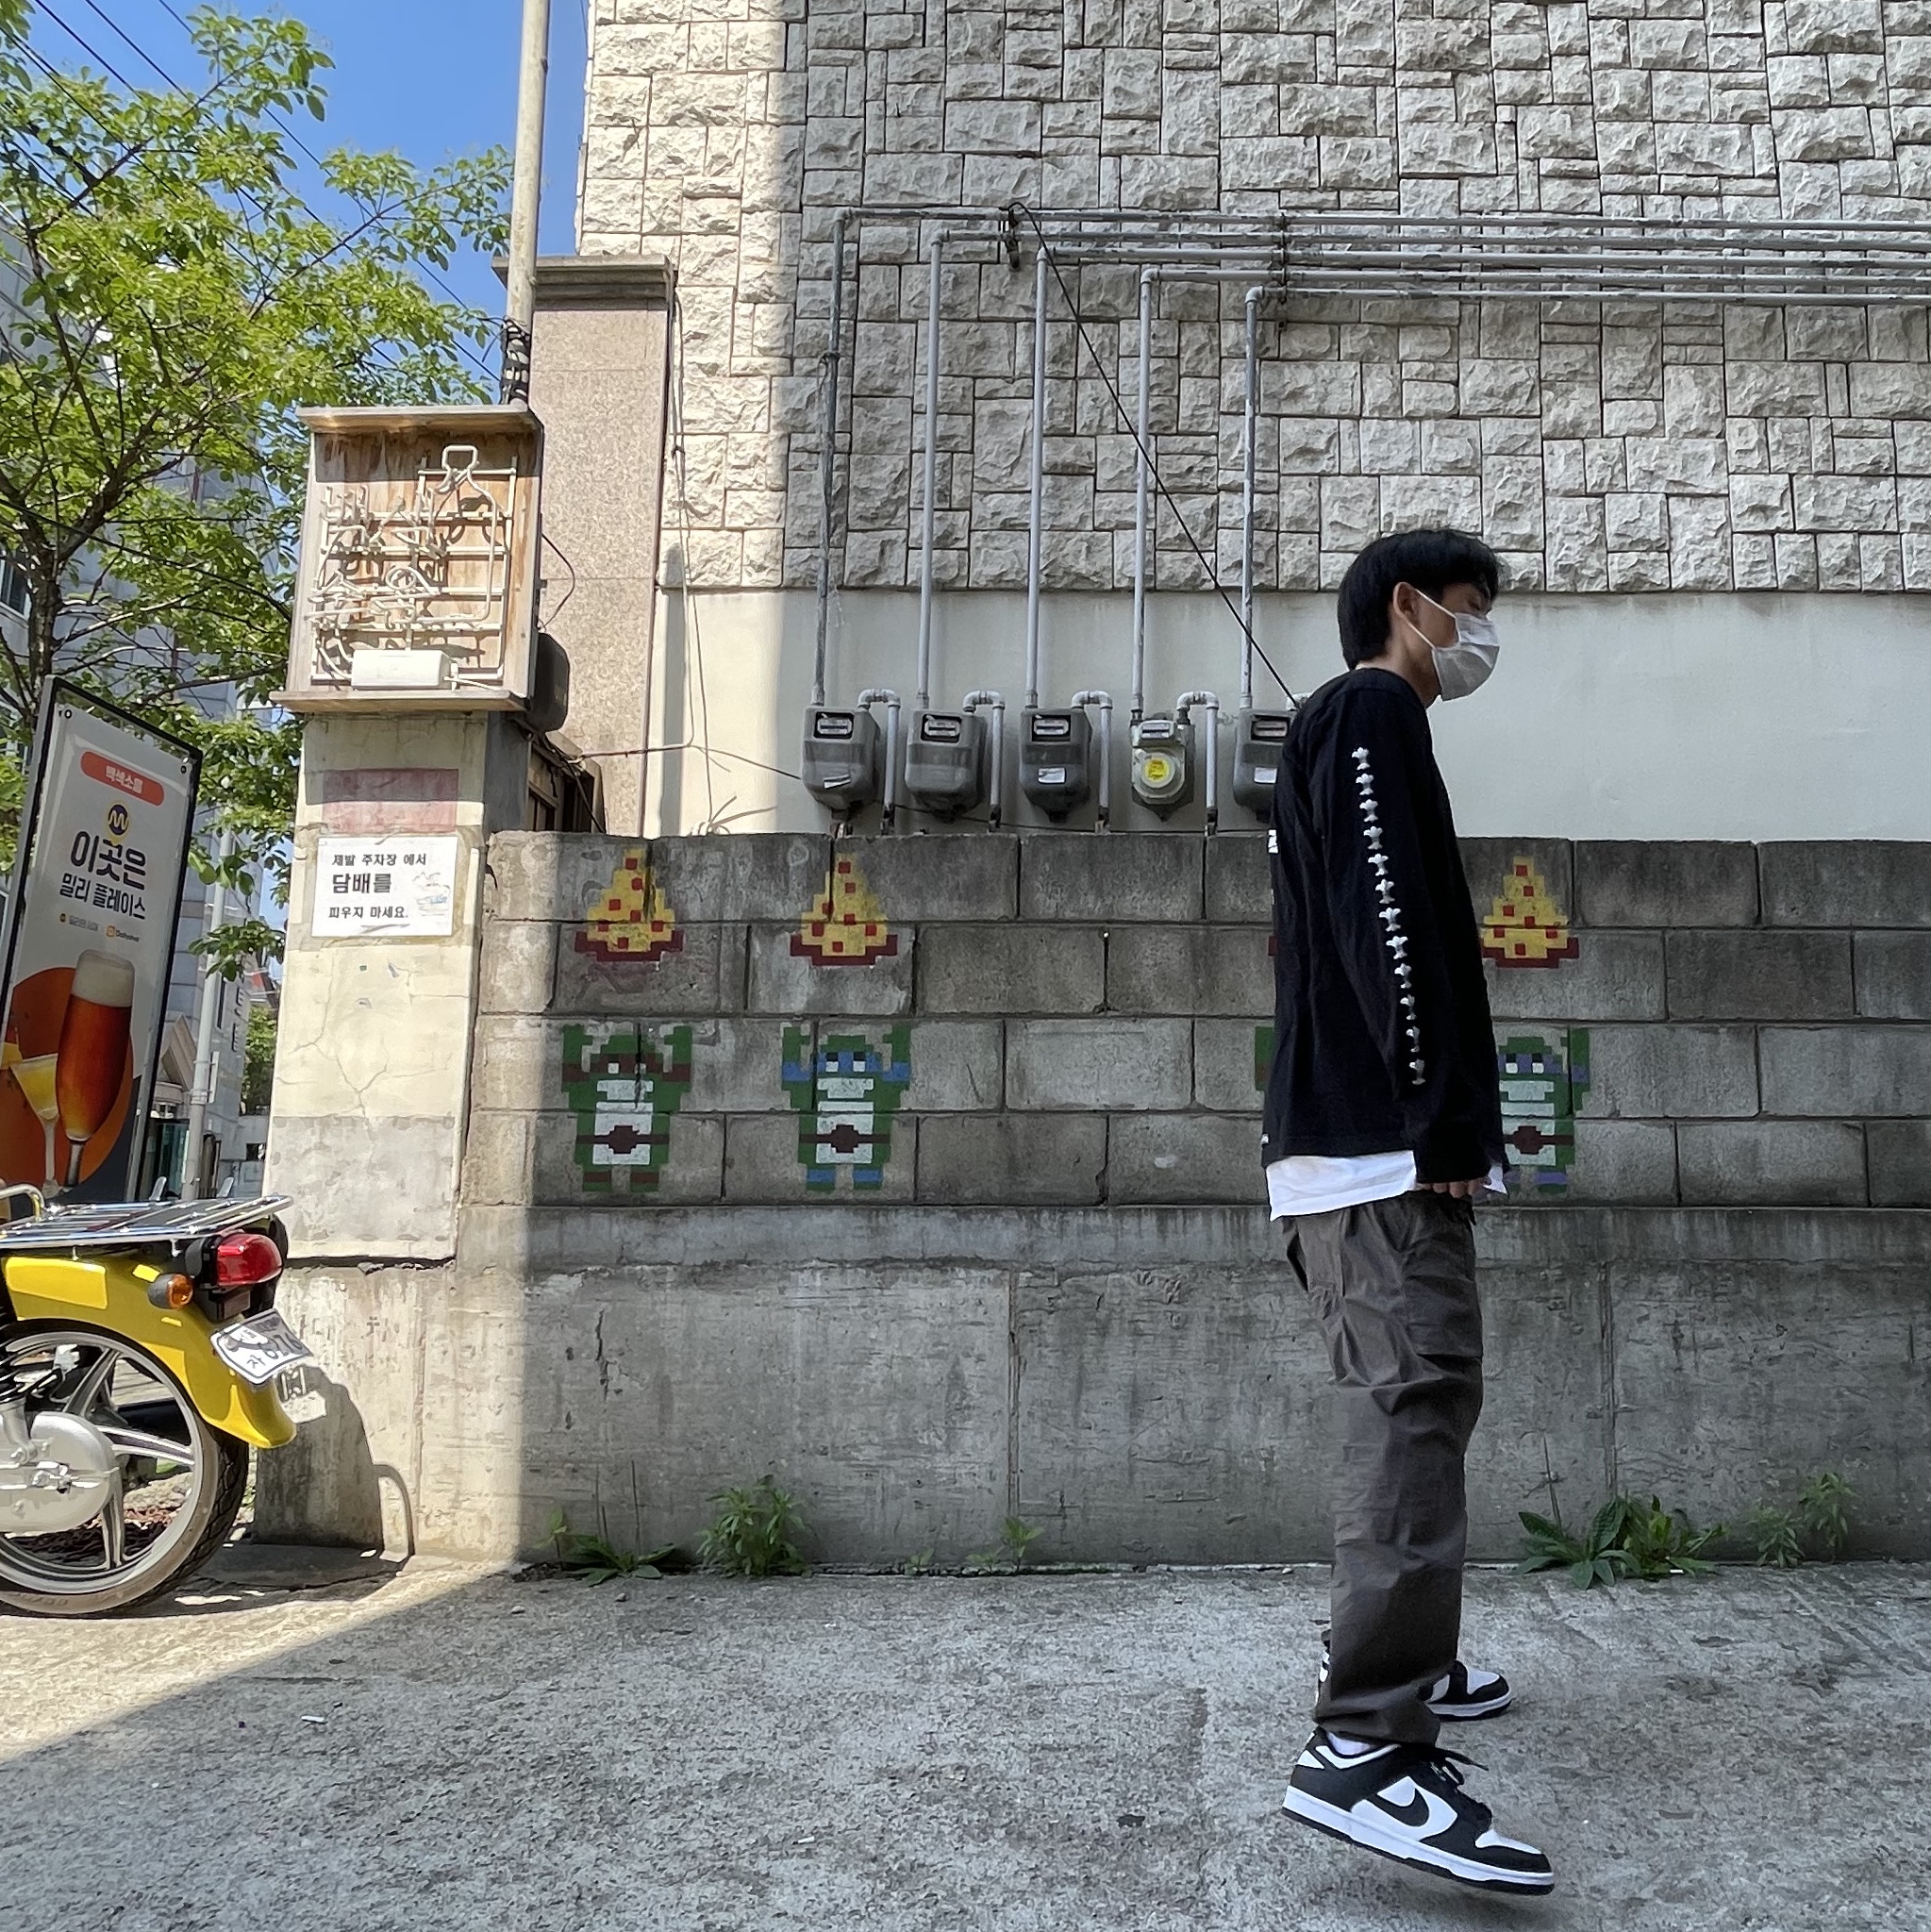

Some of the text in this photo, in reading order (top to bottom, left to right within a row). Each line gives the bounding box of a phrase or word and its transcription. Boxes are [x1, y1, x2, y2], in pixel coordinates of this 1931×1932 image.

[71, 830, 146, 891] 이곳은
[332, 854, 355, 866] 제발
[404, 853, 426, 866] 에서
[332, 873, 391, 893] 담배를
[59, 873, 145, 920] 밀리 플레이스
[328, 906, 408, 919] 피우지 마세요.
